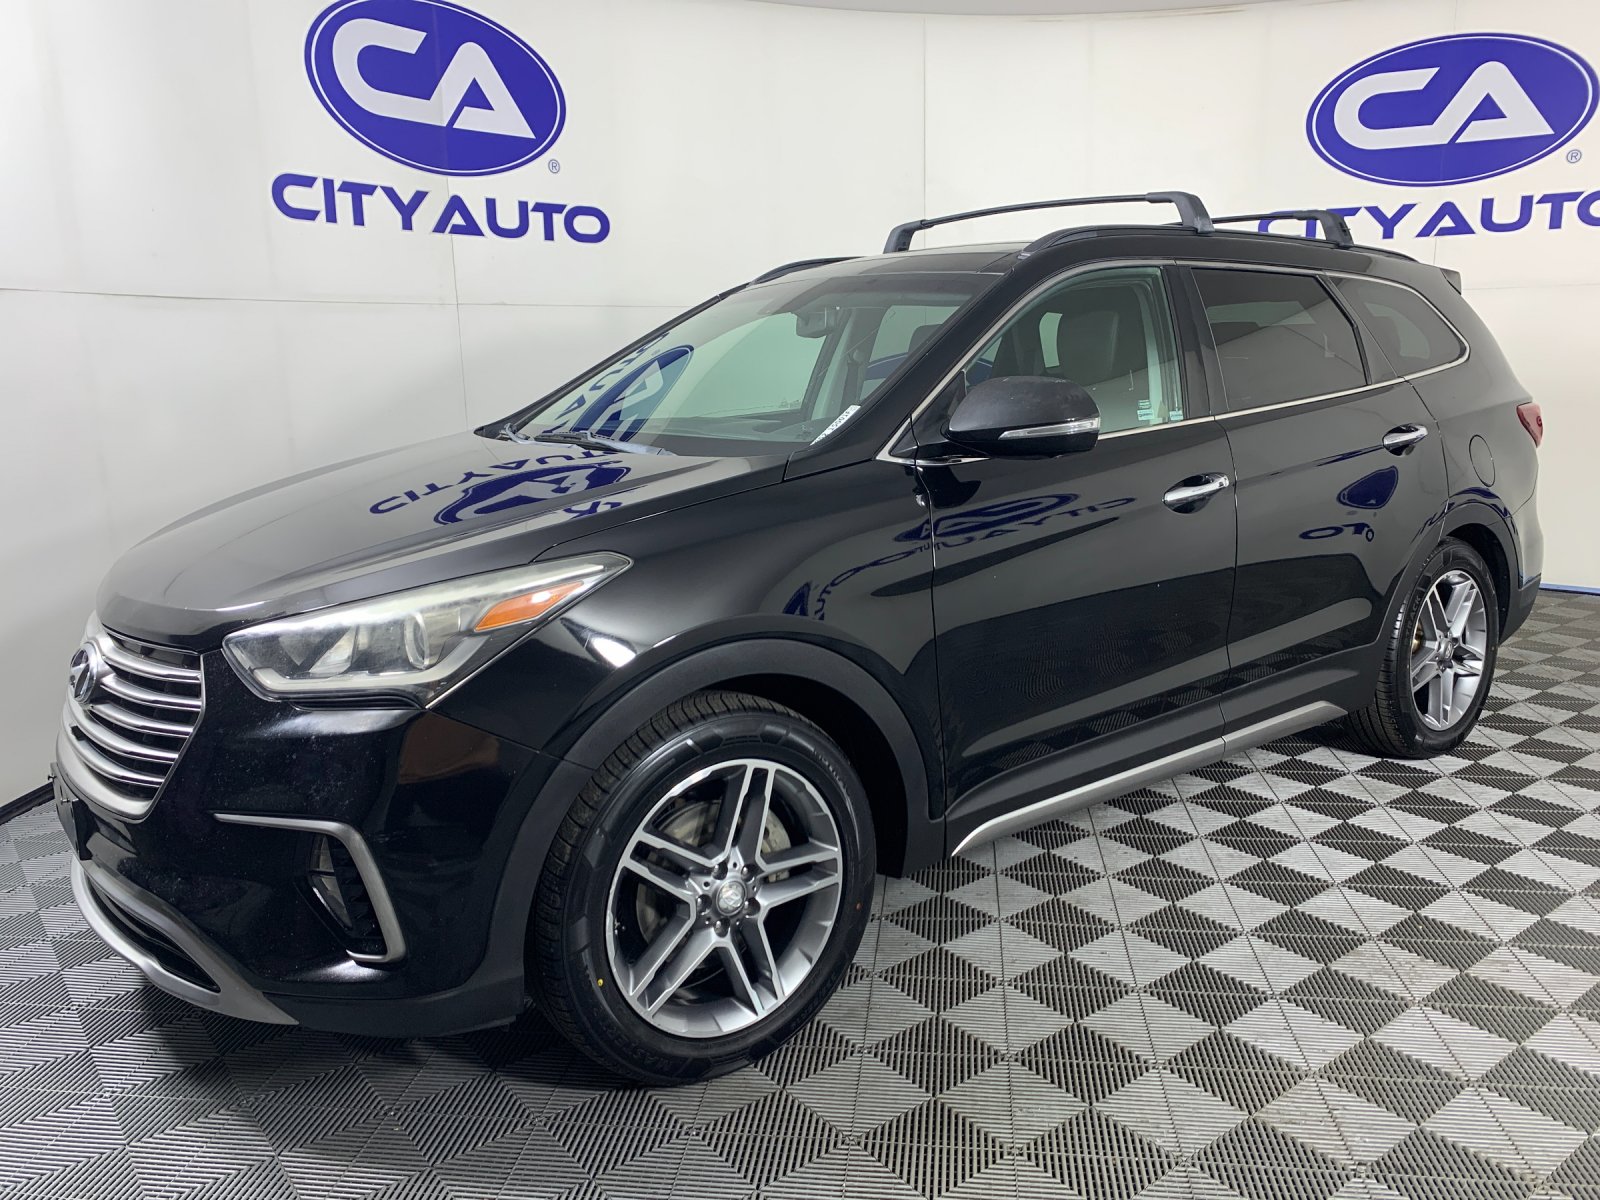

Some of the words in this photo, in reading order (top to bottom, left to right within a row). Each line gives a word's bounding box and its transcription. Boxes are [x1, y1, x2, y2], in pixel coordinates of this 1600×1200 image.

[332, 17, 537, 139] CA
[1333, 60, 1555, 150] CA
[271, 173, 429, 231] CITY
[431, 194, 611, 243] AUTO
